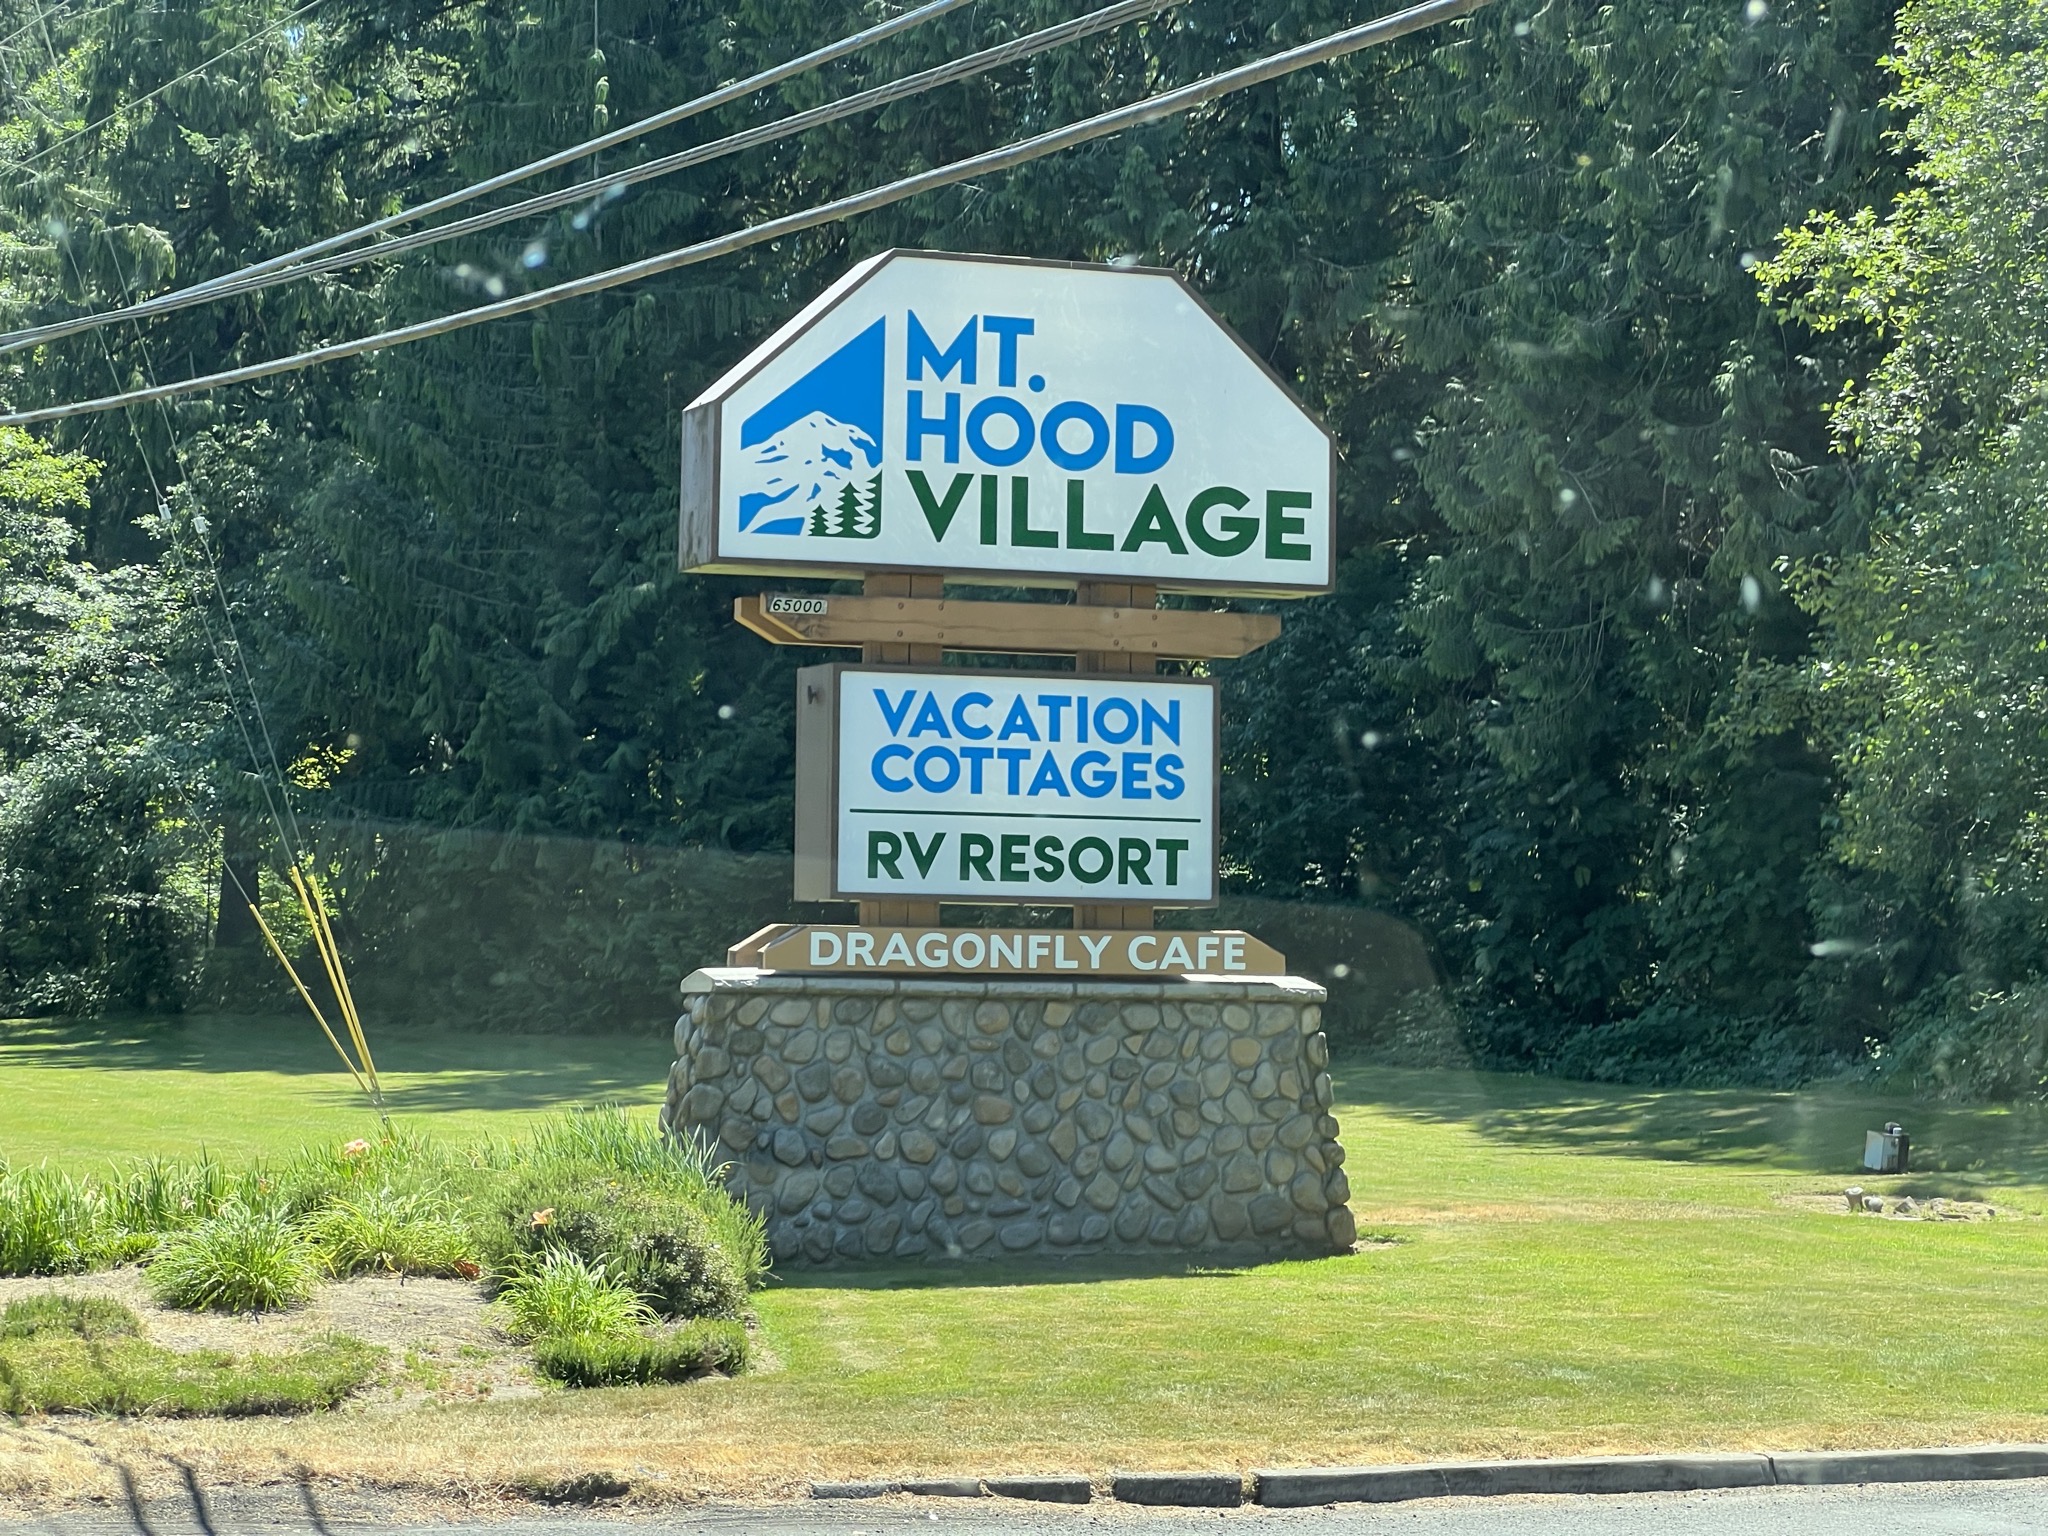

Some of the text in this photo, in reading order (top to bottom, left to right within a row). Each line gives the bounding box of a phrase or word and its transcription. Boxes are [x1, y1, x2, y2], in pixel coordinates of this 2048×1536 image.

[906, 309, 1045, 392] MT.
[905, 390, 1175, 474] HOOD
[905, 470, 1312, 561] VILLAGE
[772, 599, 822, 613] 65000
[873, 688, 1180, 746] VACATION
[871, 744, 1185, 800] COTTAGES
[867, 831, 1189, 886] RV RESORT
[810, 931, 1246, 971] DRAGONFLY CAFE
